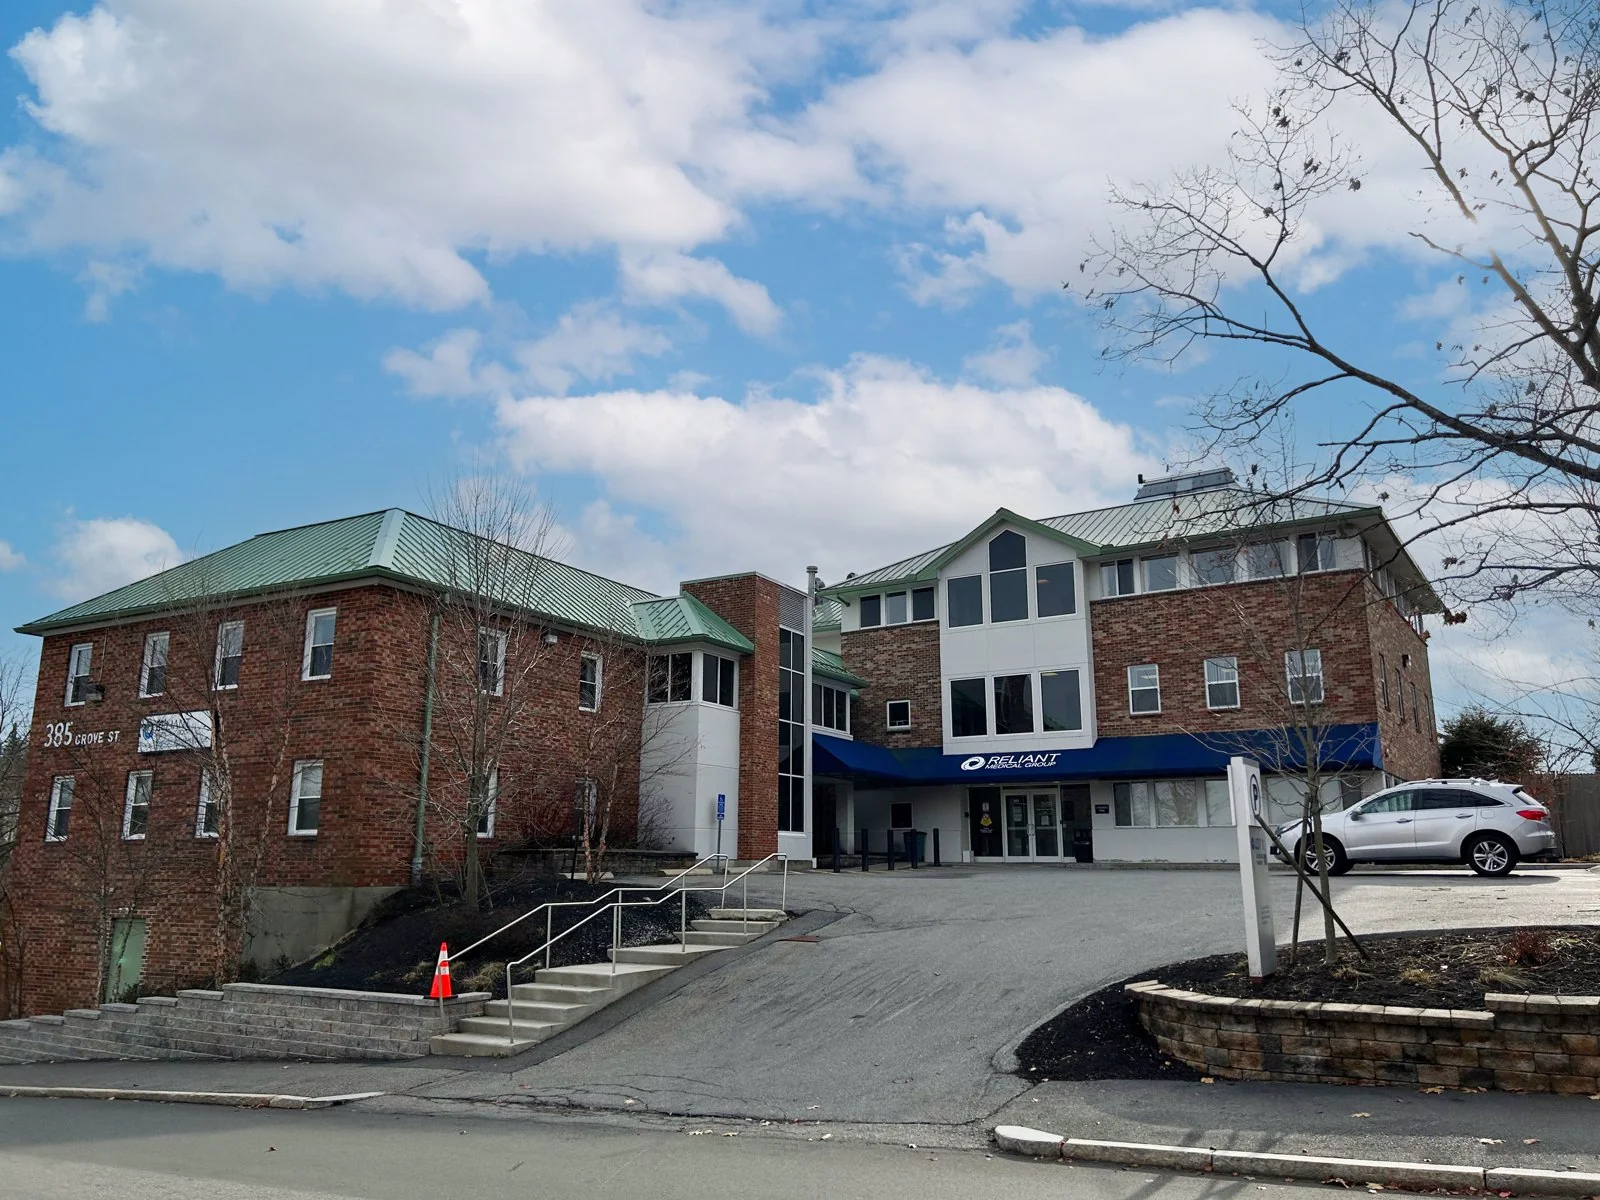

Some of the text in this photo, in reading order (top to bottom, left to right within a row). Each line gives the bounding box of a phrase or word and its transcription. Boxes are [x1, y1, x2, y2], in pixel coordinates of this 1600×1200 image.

[44, 721, 74, 748] 385
[75, 732, 104, 746] GROVE
[987, 753, 1062, 765] RELIANT
[985, 762, 1022, 770] MEDICAL
